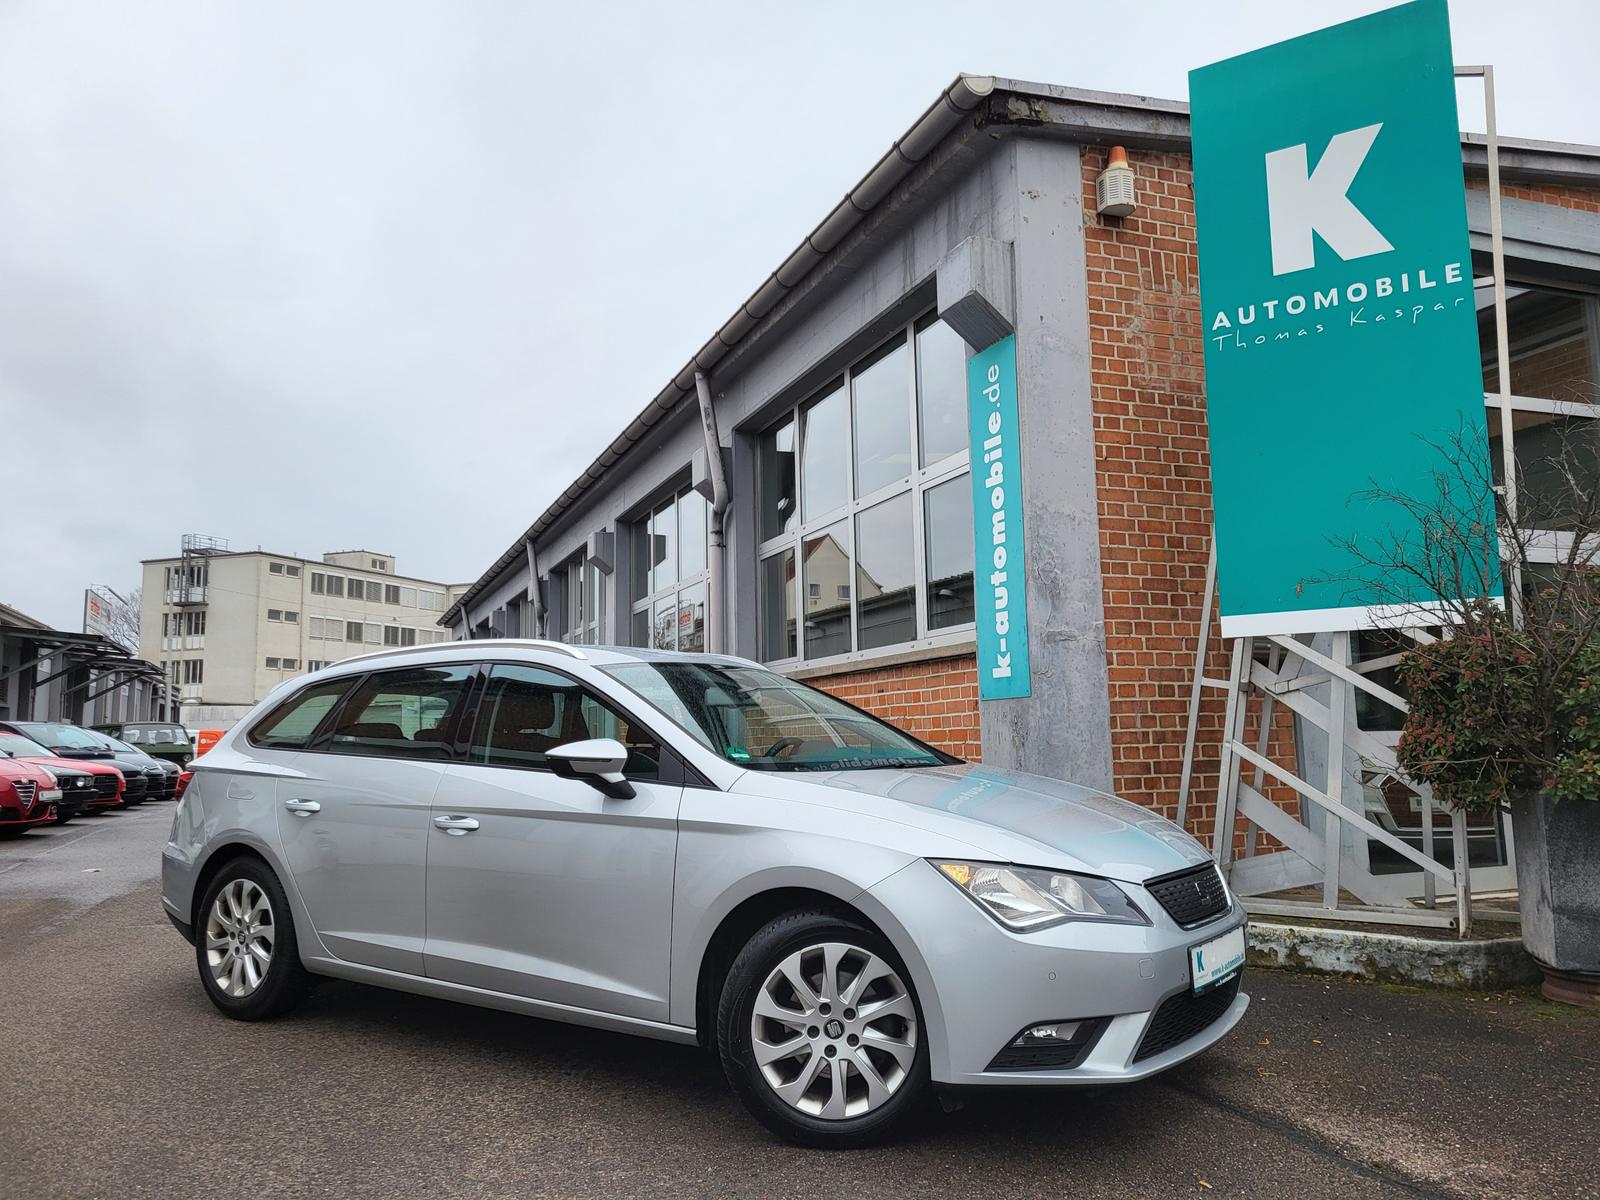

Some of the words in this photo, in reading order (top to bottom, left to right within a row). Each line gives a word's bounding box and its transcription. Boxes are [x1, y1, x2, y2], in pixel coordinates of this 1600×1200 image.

[1265, 122, 1396, 277] K
[1212, 262, 1464, 331] AUTOMOBILE
[1213, 329, 1325, 351] Thomas
[1350, 297, 1465, 327] Kaspar
[983, 363, 1012, 679] k-automobile.de
[1196, 950, 1205, 973] K
